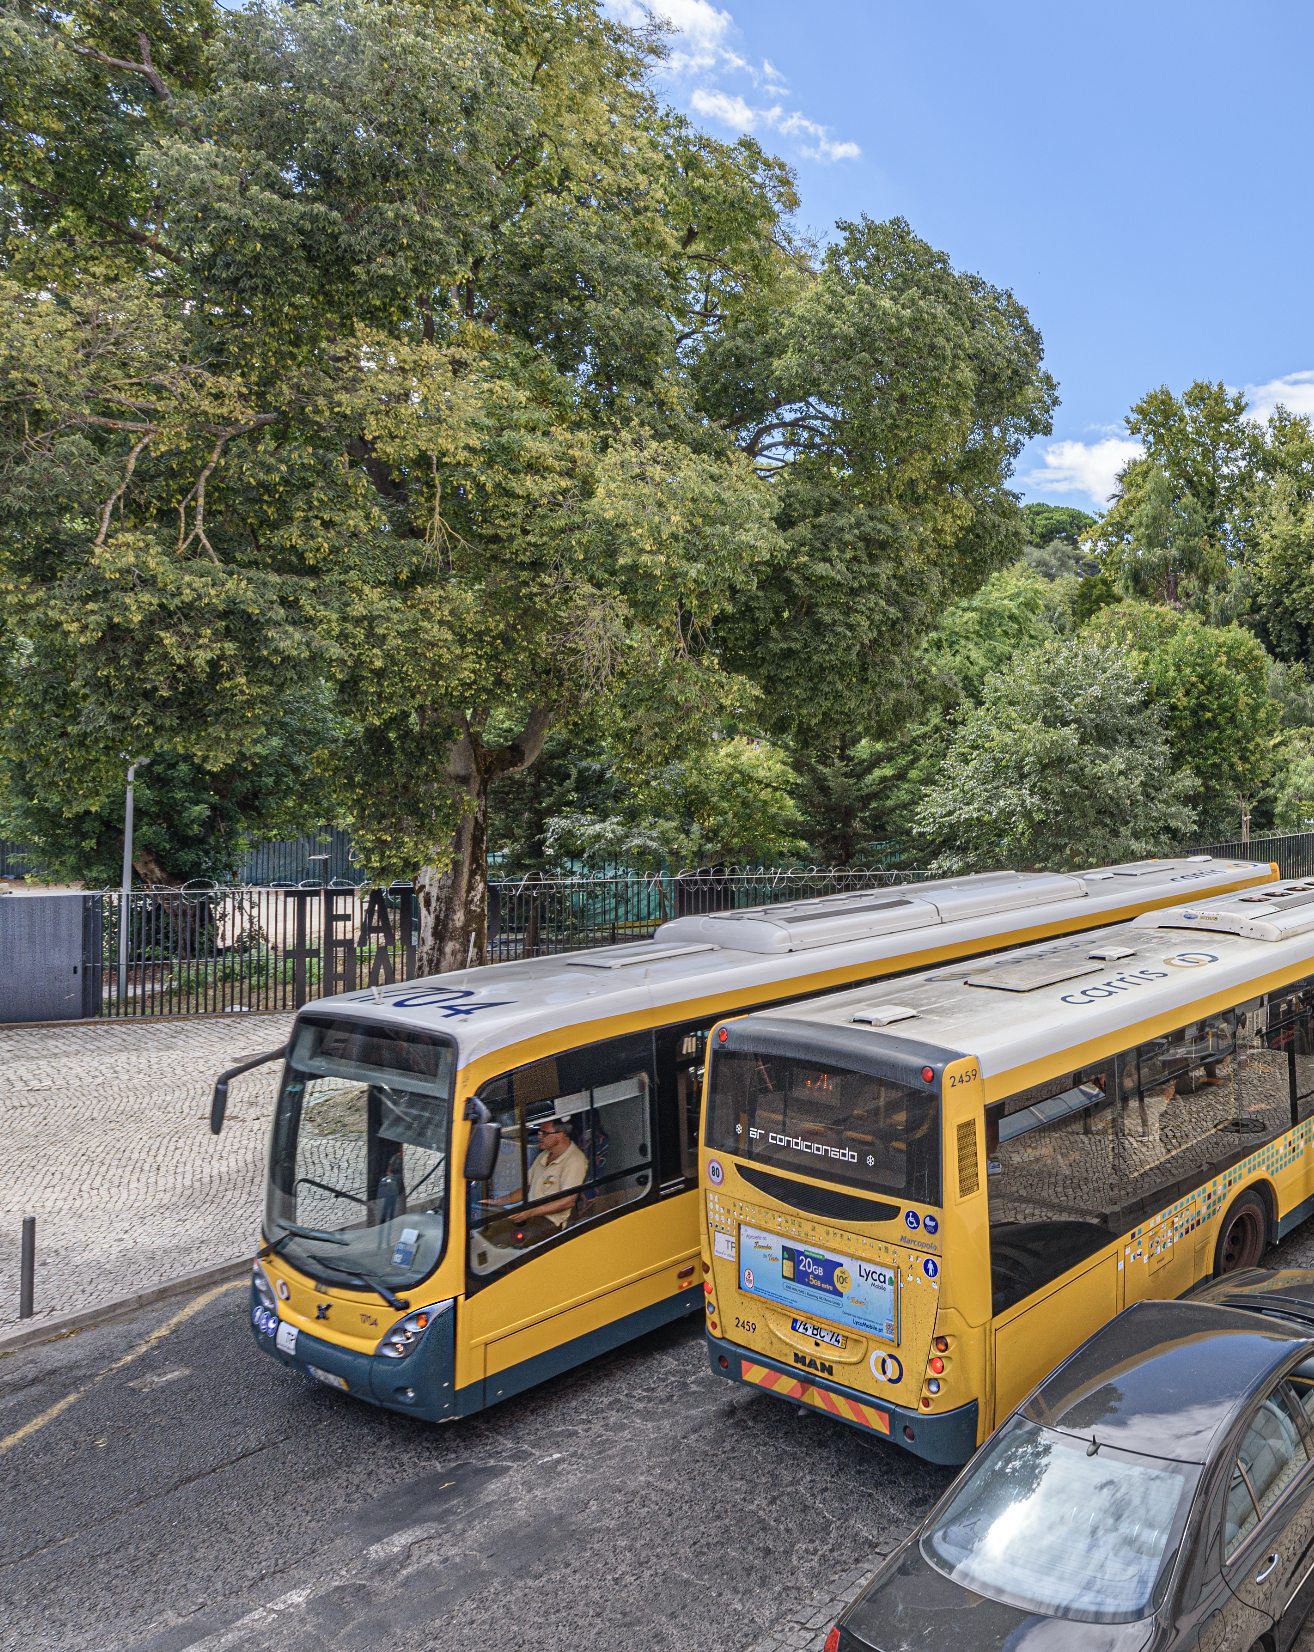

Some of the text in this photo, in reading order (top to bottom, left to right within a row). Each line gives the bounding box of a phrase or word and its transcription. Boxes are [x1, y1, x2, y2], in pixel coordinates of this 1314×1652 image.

[1170, 869, 1227, 883] carris
[1060, 969, 1169, 1005] carris
[347, 986, 519, 1019] 1704
[949, 1069, 977, 1088] 2459
[749, 1127, 858, 1163] ar condicionado
[711, 1165, 720, 1178] 80
[900, 1235, 937, 1251] Marcopolo
[799, 1255, 824, 1276] 20GB
[809, 1274, 821, 1287] 5GB
[859, 1264, 887, 1285] Lyca
[871, 1282, 887, 1292] Mobile
[735, 1317, 757, 1333] 2459
[852, 1318, 884, 1334] LycaMobile.pt
[793, 1351, 834, 1376] MAN
